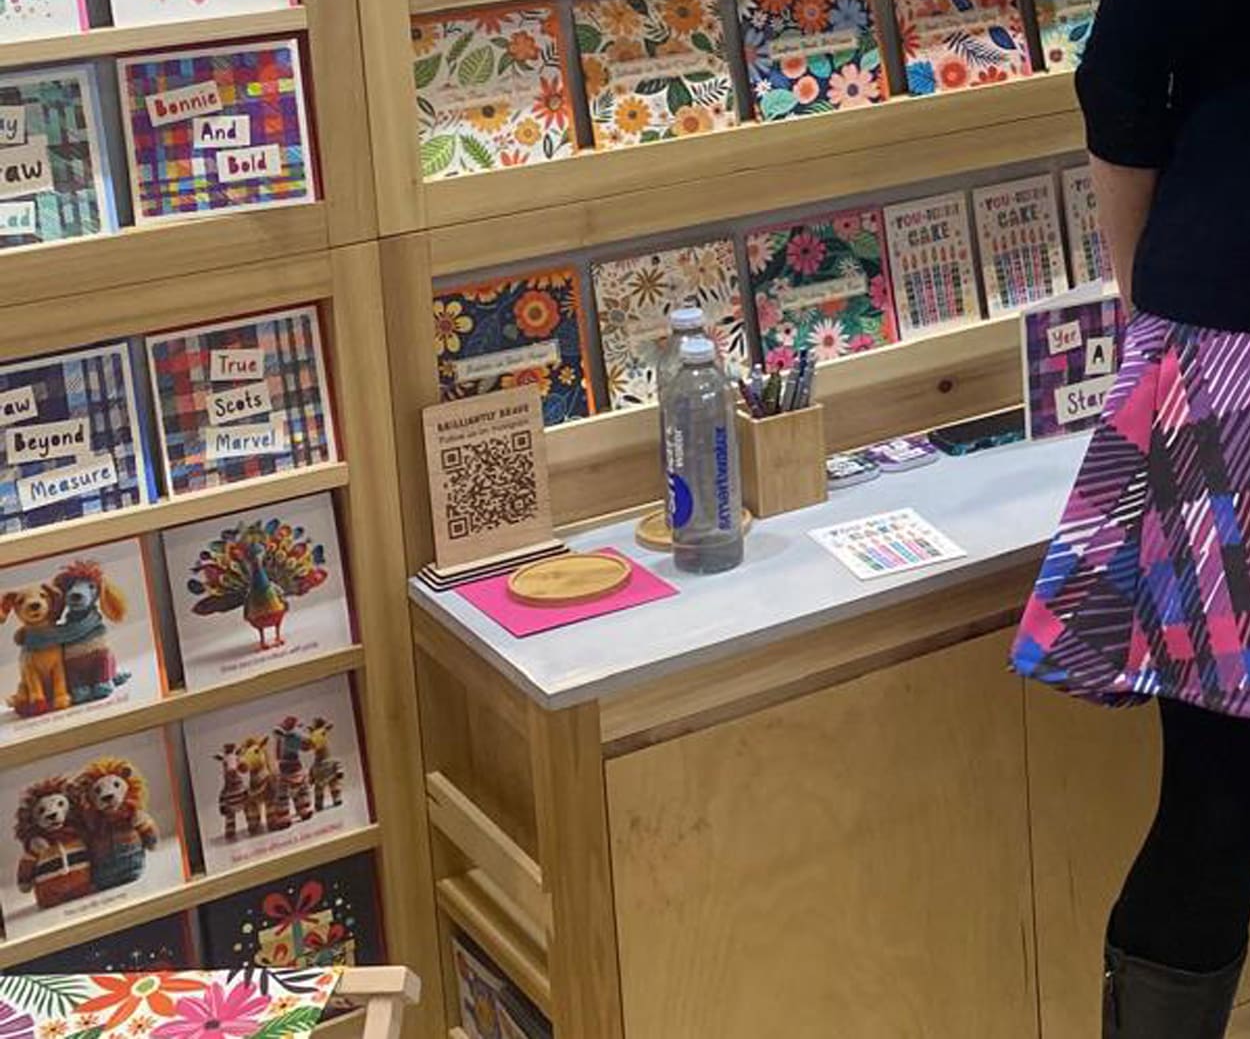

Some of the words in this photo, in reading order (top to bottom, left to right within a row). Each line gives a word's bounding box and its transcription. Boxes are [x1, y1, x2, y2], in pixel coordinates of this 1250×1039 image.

[154, 92, 218, 117] Bonnie
[201, 120, 237, 140] And
[227, 153, 267, 175] Bold
[998, 204, 1039, 228] CAKE
[907, 221, 950, 246] CAKE
[1052, 327, 1077, 350] Yer
[219, 355, 256, 374] True
[1092, 343, 1104, 364] A
[215, 390, 263, 417] Scots
[1067, 389, 1105, 415] Star
[14, 424, 85, 457] Beyond
[216, 430, 275, 450] Marvel
[30, 466, 112, 501] Measure
